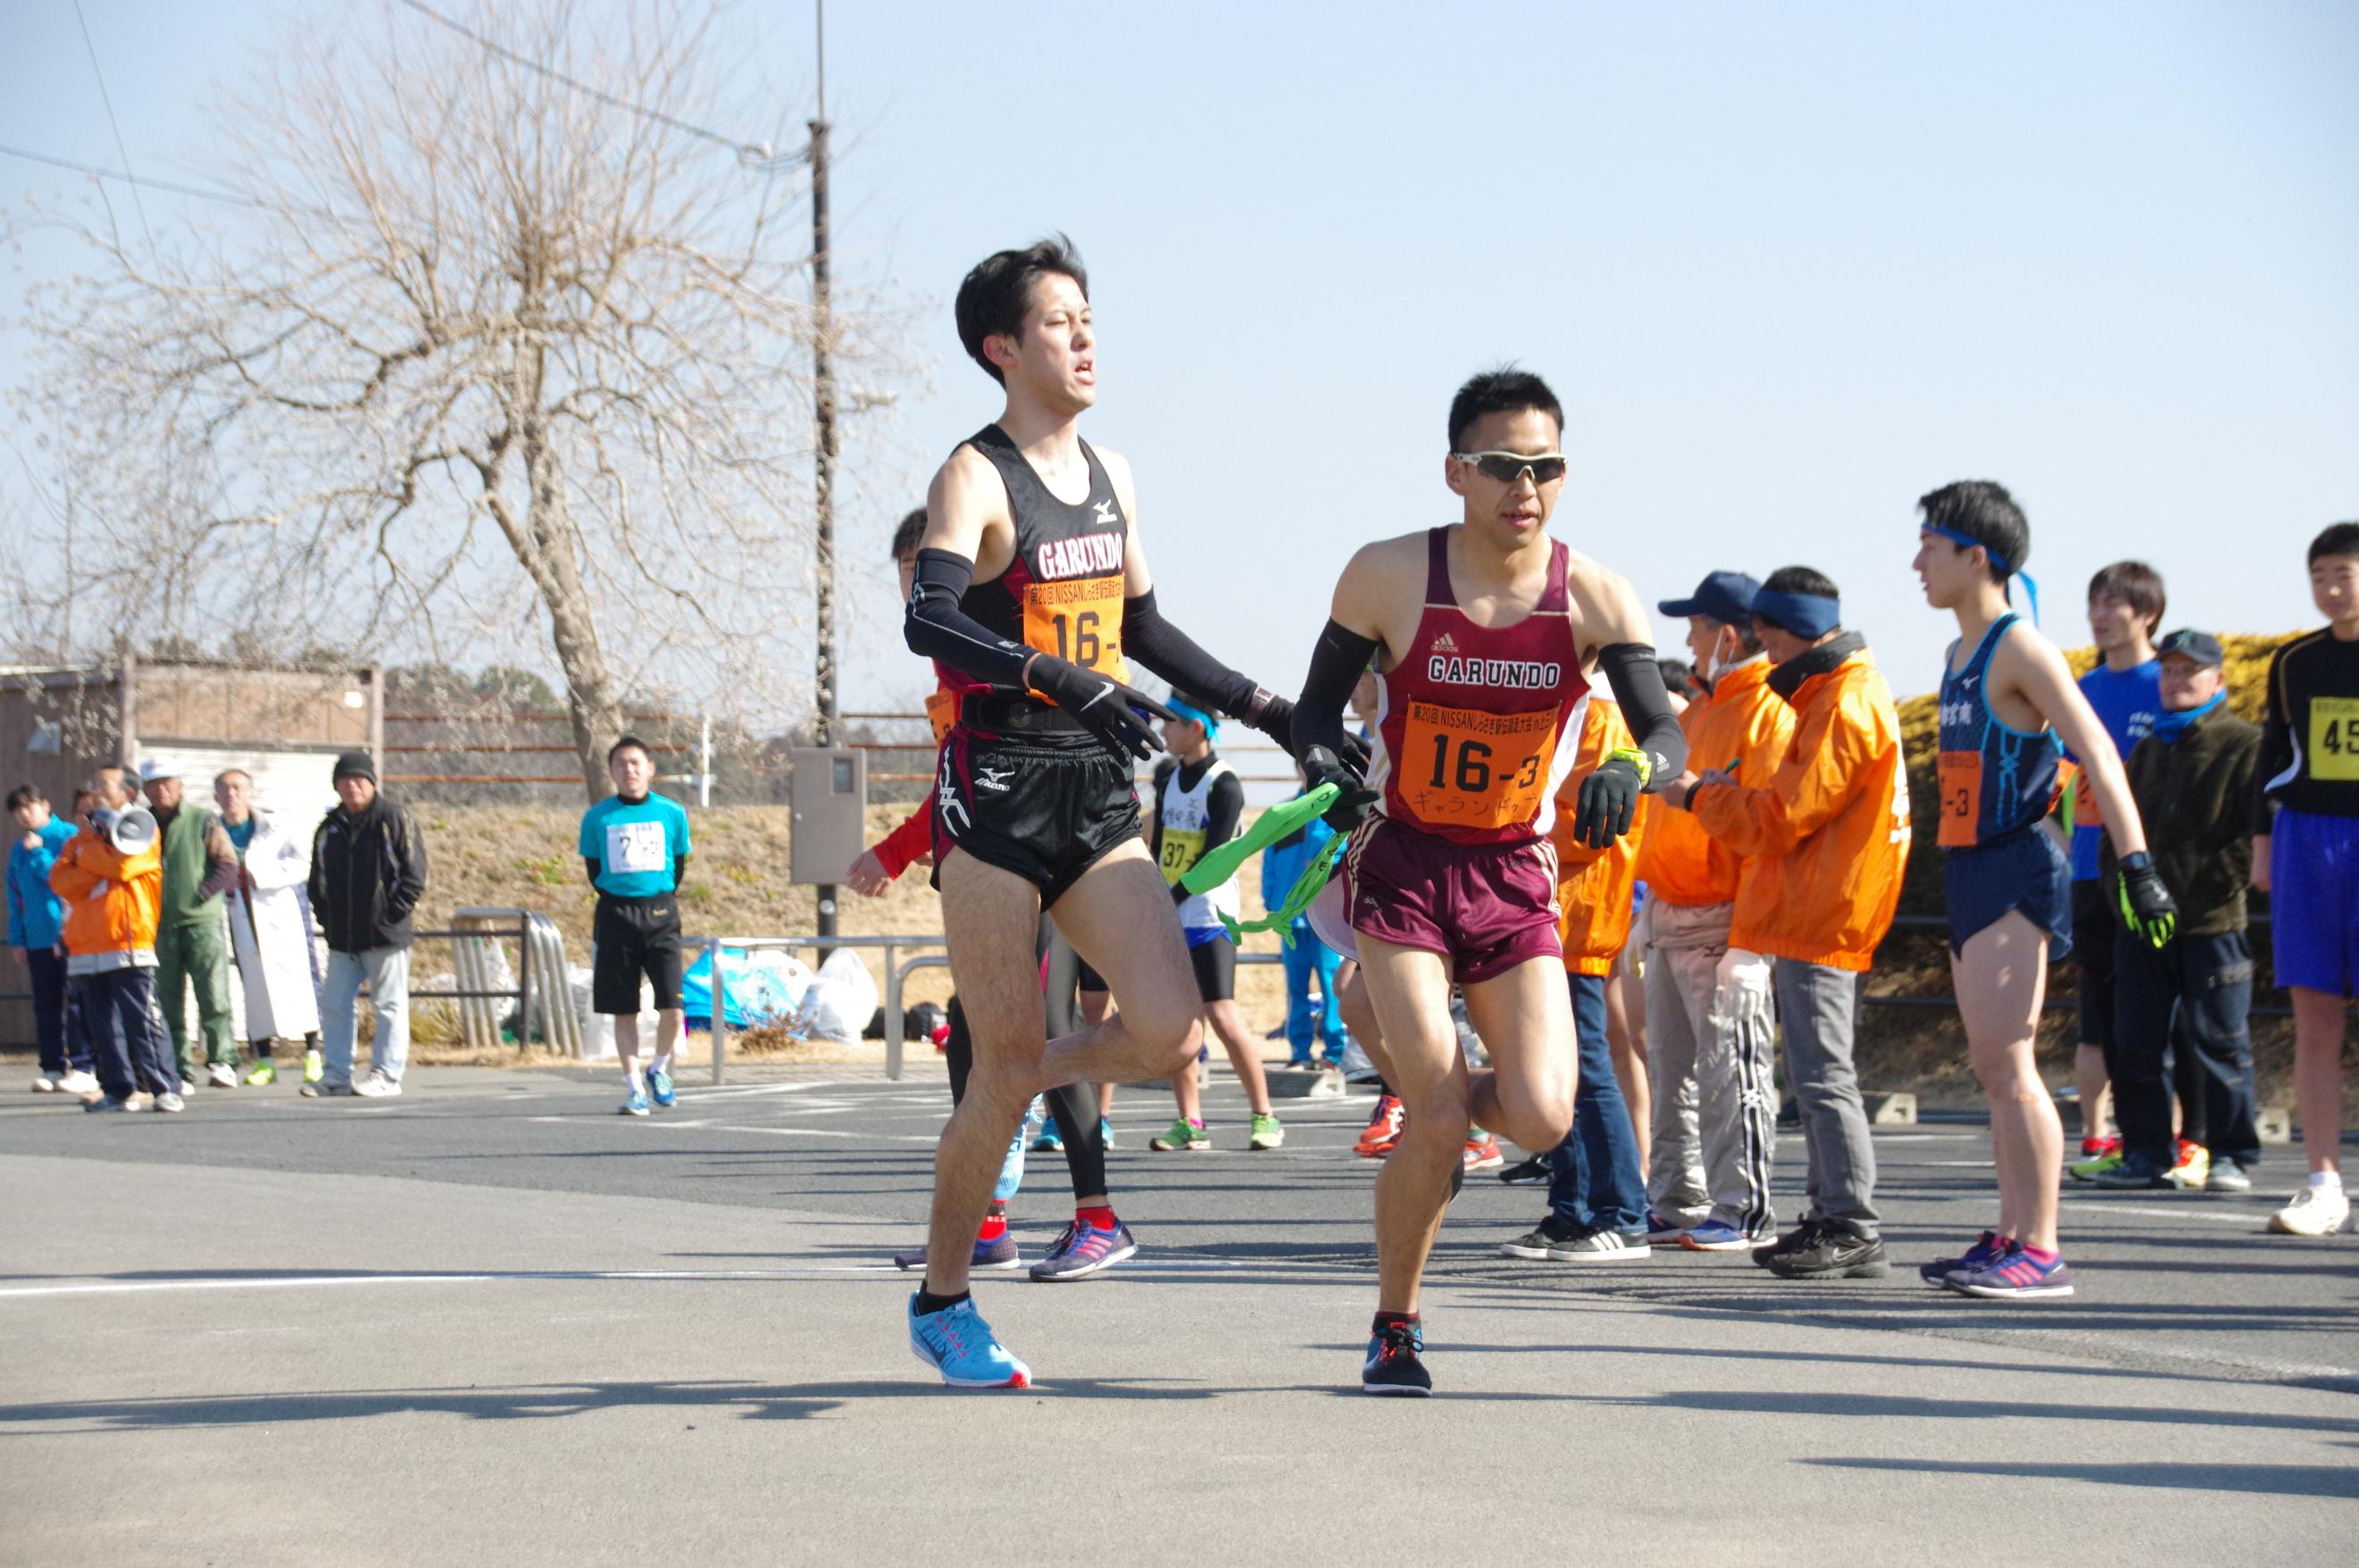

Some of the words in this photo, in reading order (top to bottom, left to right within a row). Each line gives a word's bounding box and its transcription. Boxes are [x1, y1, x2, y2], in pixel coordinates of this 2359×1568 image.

[1038, 532, 1123, 580] GARUNDO
[1052, 611, 1122, 668] 16-
[1430, 644, 1459, 653] adidas
[1429, 655, 1561, 689] GARUNDO
[1430, 733, 1541, 793] 16-3
